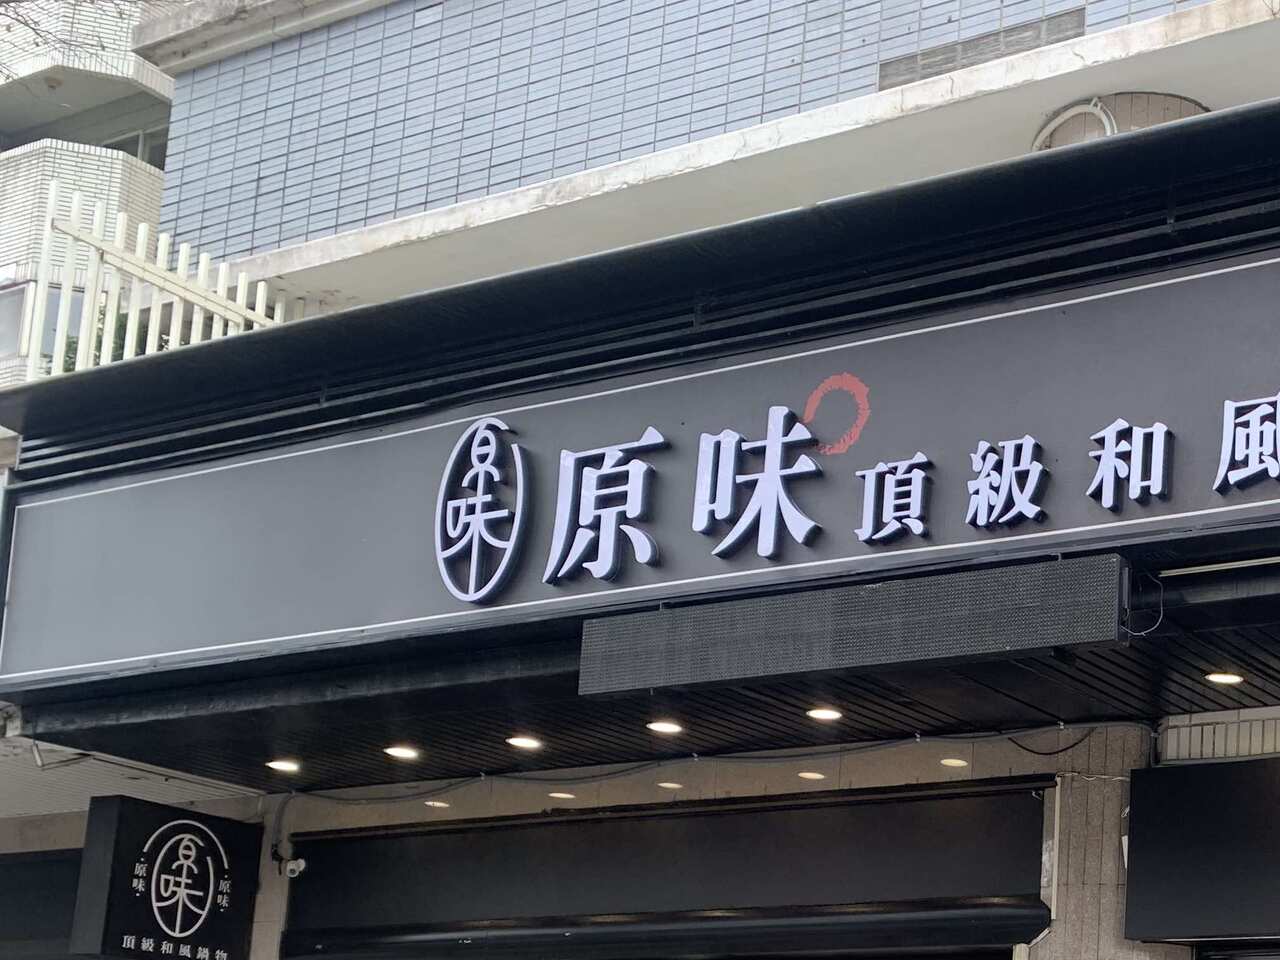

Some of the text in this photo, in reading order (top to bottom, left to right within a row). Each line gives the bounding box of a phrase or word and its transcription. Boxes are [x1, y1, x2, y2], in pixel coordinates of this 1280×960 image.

[542, 405, 823, 585] 原味
[132, 862, 148, 892] 原味
[217, 880, 232, 907] 原味
